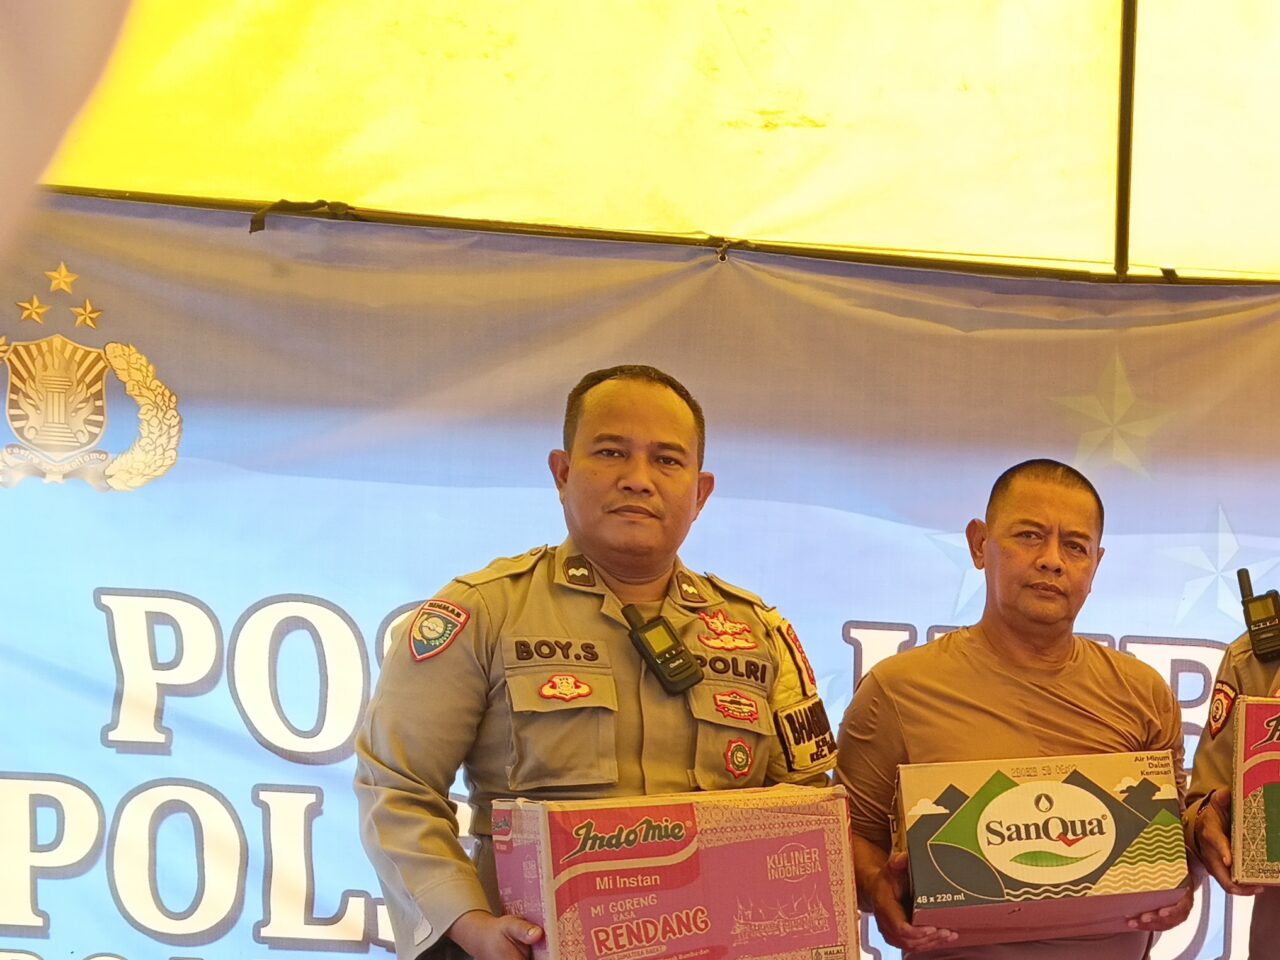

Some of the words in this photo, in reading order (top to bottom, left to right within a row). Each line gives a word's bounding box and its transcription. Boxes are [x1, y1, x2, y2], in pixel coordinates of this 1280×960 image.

[514, 640, 599, 662] BOY.S
[1140, 768, 1172, 777] Kemasan
[985, 814, 1107, 848] SanQua
[766, 848, 820, 870] KULINER
[595, 874, 613, 890] Mi
[615, 871, 660, 889] Instan
[767, 863, 823, 881] INDONESIA
[590, 905, 605, 918] MI
[608, 893, 658, 914] GORENG
[916, 895, 928, 905] 48
[936, 893, 952, 903] 220
[612, 911, 637, 923] RASA
[591, 905, 712, 957] RENDANG
